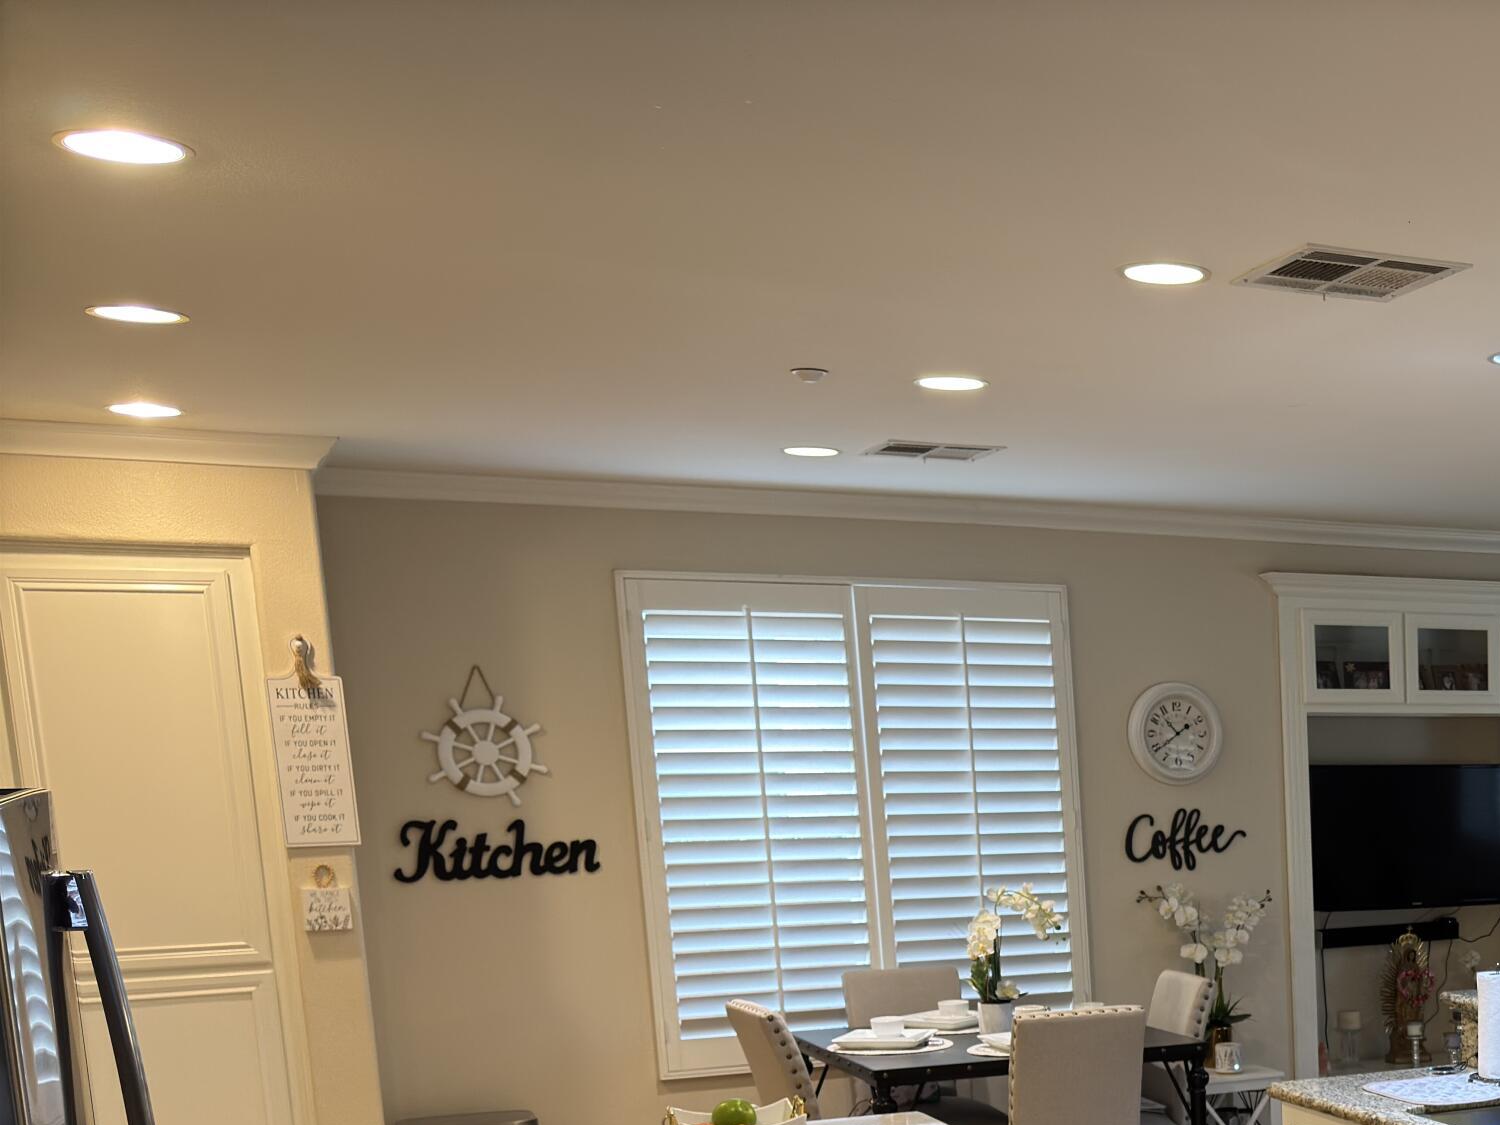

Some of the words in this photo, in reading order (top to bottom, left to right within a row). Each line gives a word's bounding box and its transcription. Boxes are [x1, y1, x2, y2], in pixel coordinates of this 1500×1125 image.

[276, 688, 334, 700] KITCHEN
[1172, 701, 1181, 712] 12
[305, 714, 328, 722] EMPTY
[291, 723, 311, 737] fill
[316, 725, 328, 735] it
[320, 749, 332, 759] it
[324, 775, 335, 784] it
[315, 789, 335, 797] SPILL
[324, 798, 336, 808] it
[331, 824, 343, 834] it
[1125, 808, 1247, 871] Coffee
[393, 818, 601, 884] Kitchen
